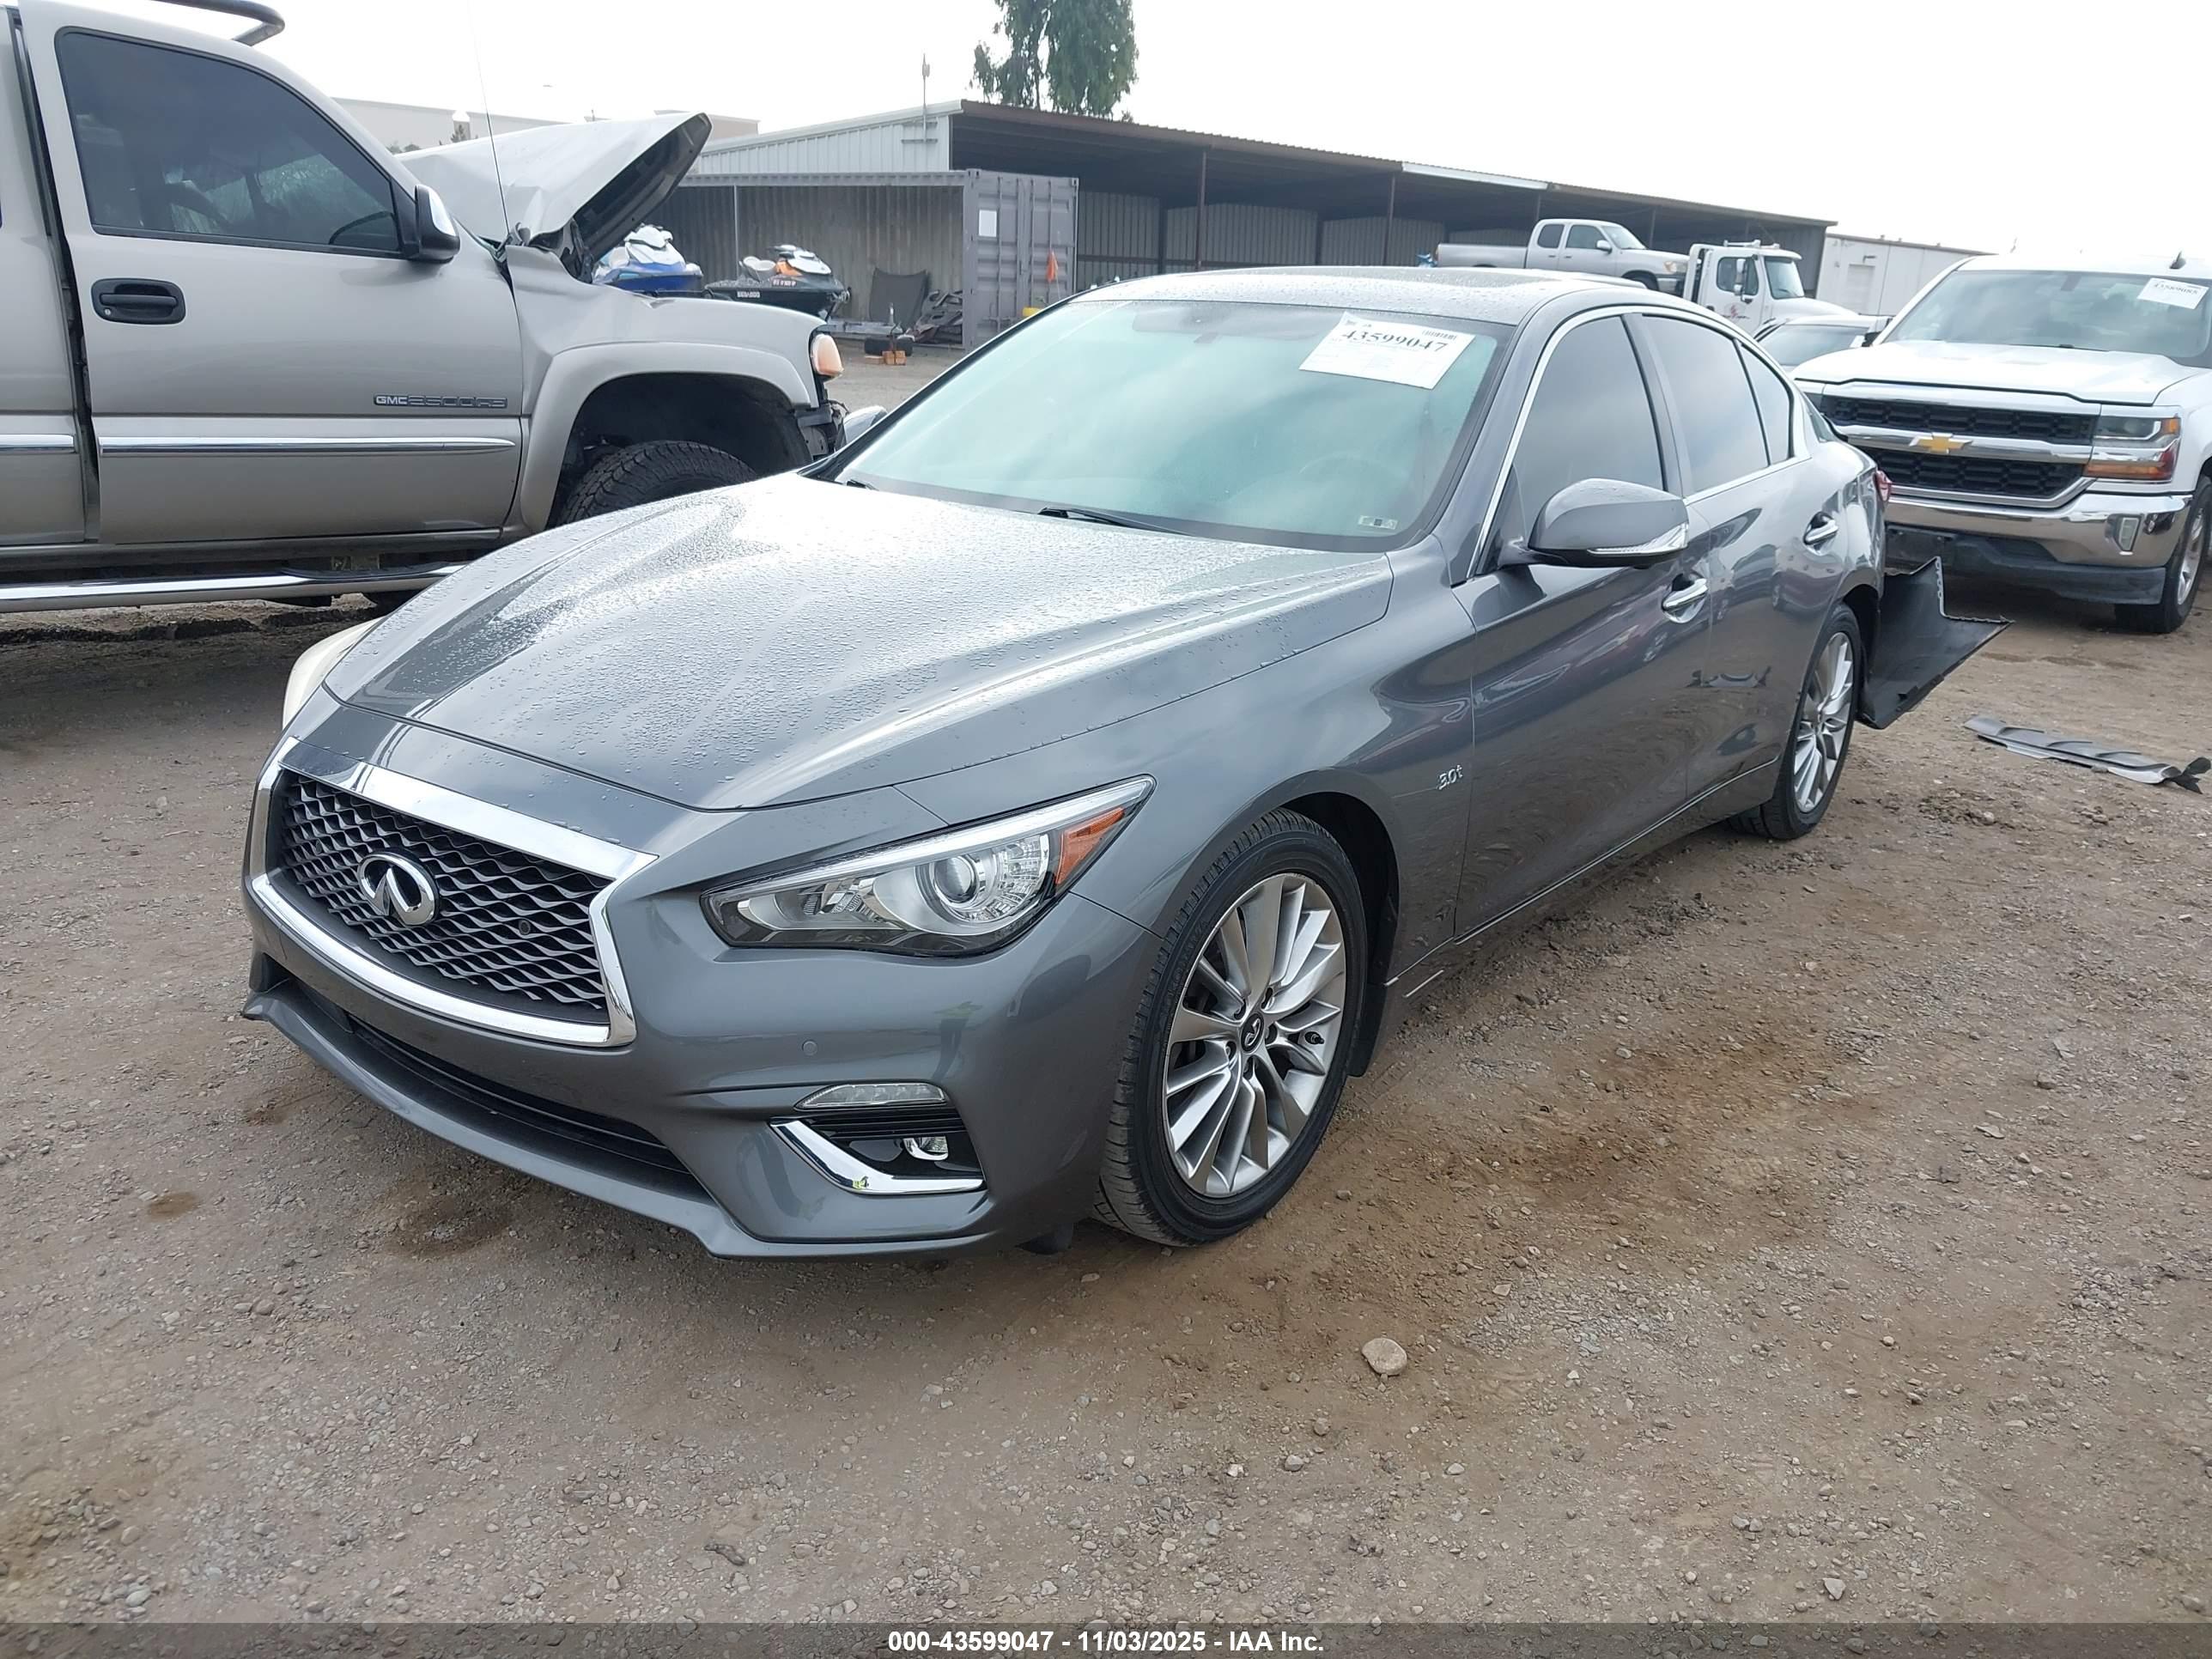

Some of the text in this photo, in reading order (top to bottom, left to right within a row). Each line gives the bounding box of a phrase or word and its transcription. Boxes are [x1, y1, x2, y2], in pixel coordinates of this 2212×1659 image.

[1341, 330, 1449, 352] 43599047
[375, 395, 408, 405] GMC
[1437, 764, 1463, 790] 3.0t
